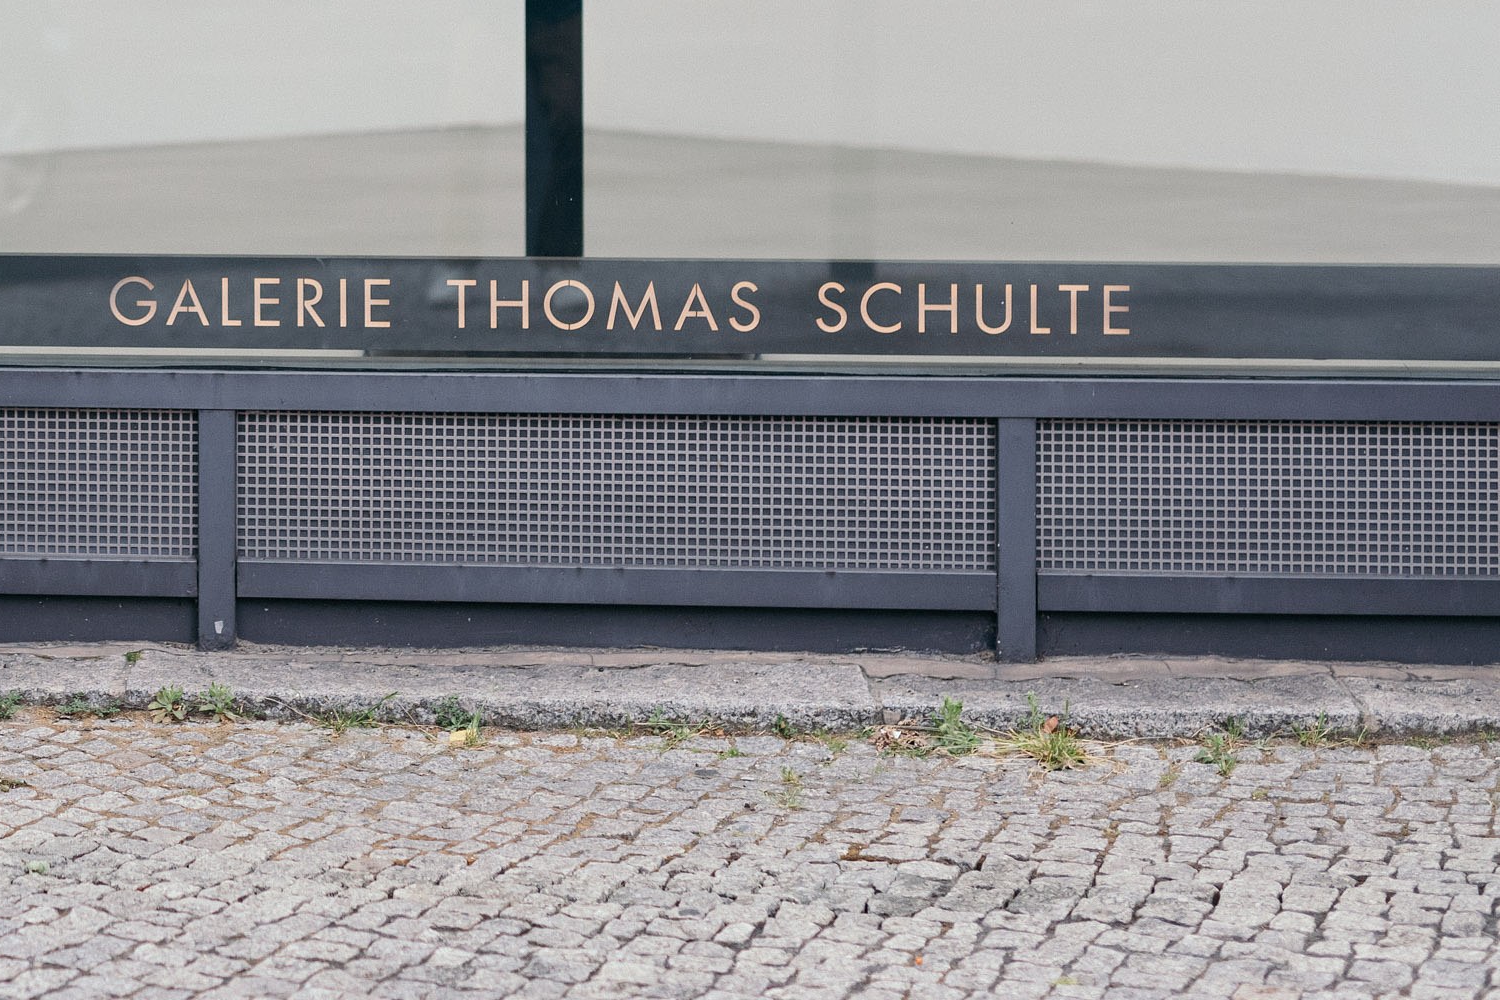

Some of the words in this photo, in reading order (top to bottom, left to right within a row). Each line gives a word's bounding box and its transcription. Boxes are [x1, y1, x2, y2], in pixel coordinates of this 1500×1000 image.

[109, 276, 391, 328] GALERIE
[446, 279, 762, 332] THOMAS
[815, 281, 1131, 335] SCHULTE
